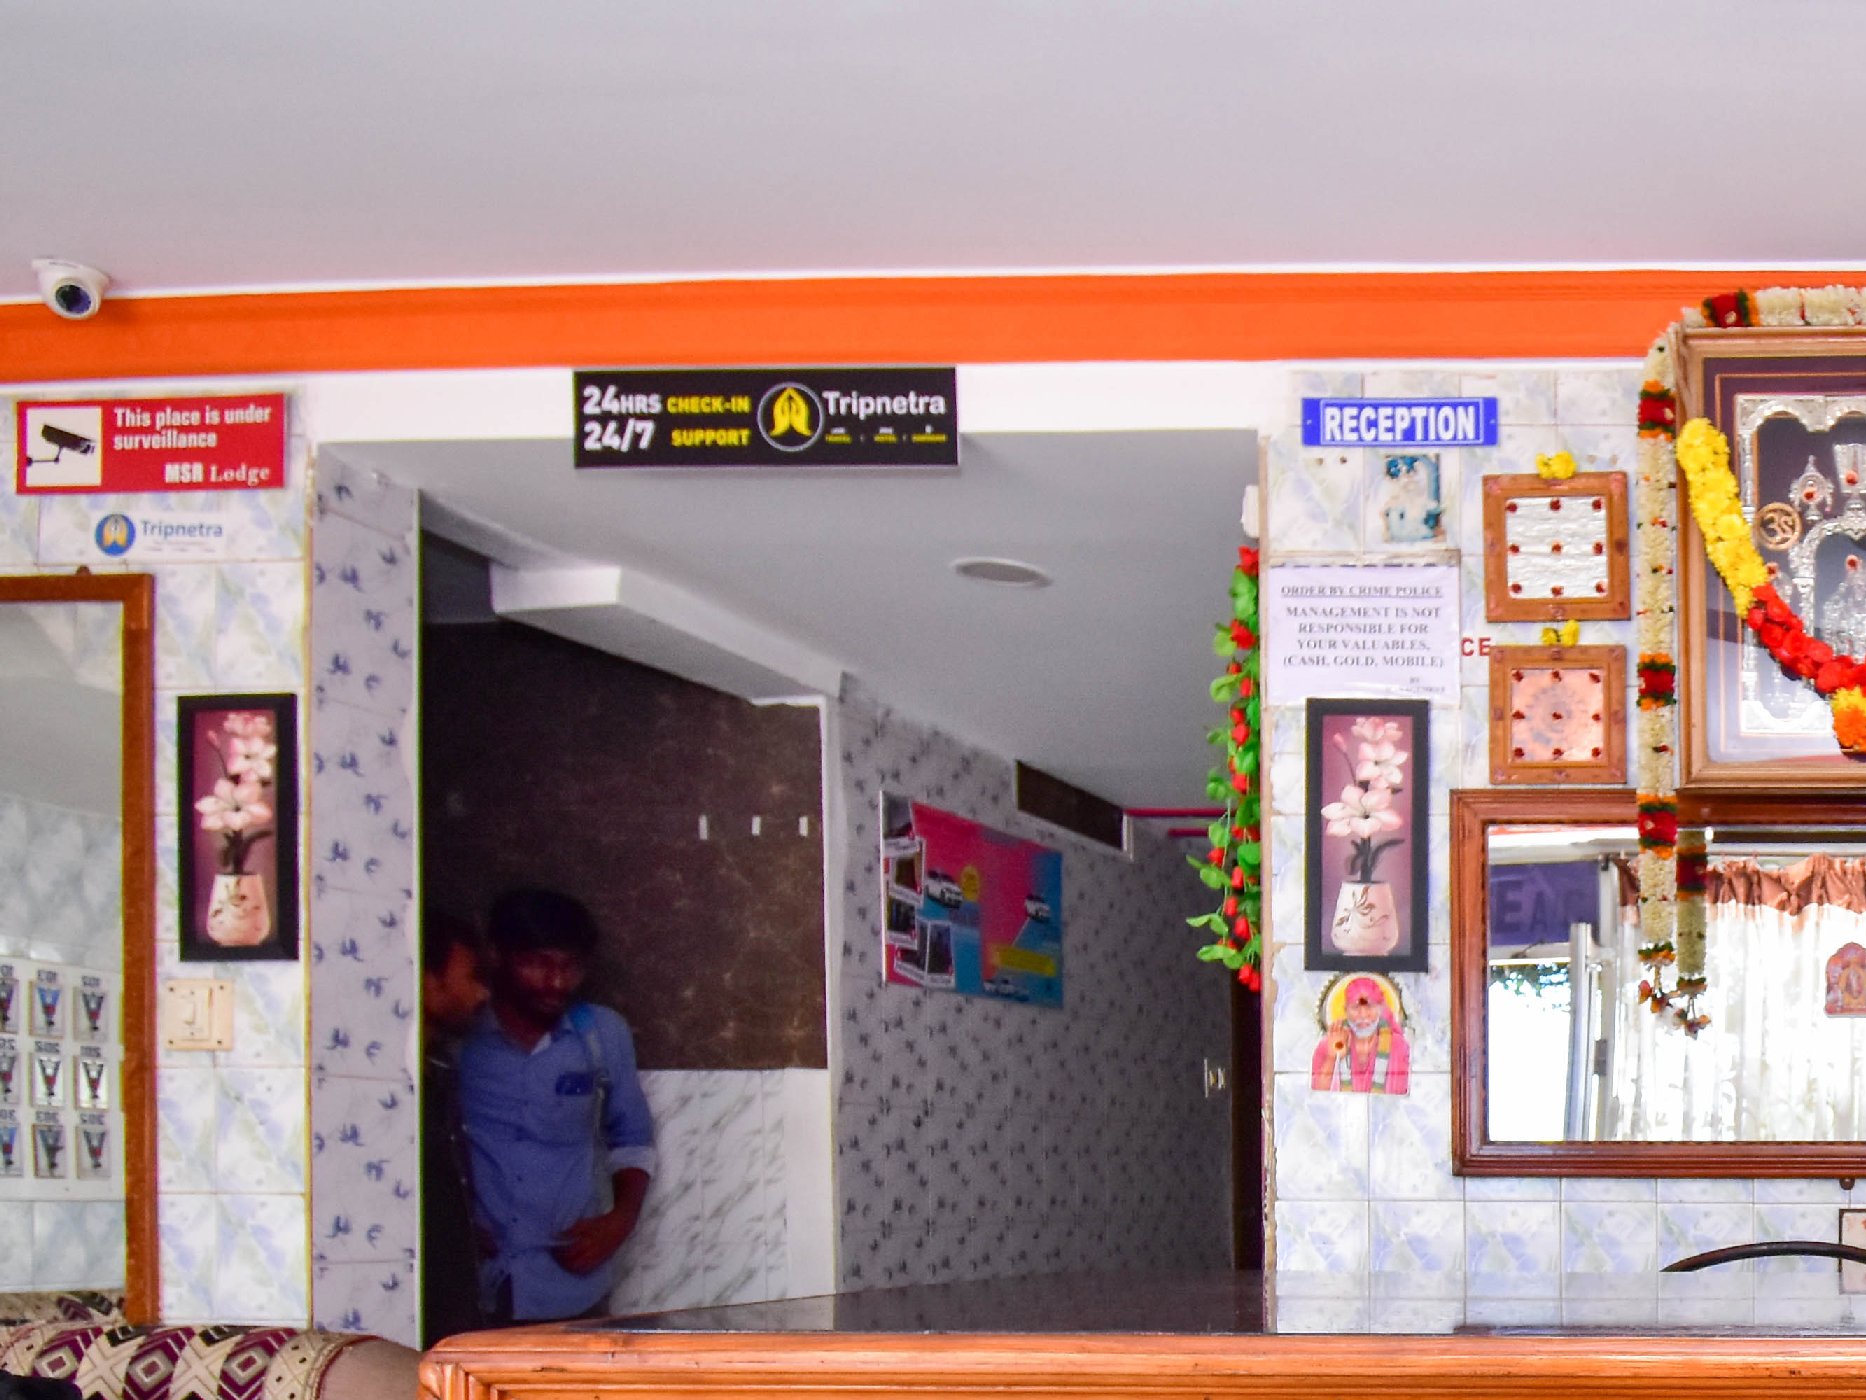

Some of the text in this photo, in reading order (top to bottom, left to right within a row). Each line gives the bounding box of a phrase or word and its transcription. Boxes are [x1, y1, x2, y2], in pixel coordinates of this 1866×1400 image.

[583, 385, 750, 415] 24HRS CHECK-IN
[822, 390, 946, 420] Tripnetra
[114, 403, 271, 431] This place is under
[1325, 405, 1475, 441] RECEPTION
[113, 428, 218, 450] surveillance
[583, 418, 750, 452] 24/7 SUPPORT
[164, 462, 270, 487] MSR Lodge
[140, 519, 223, 540] Tripnetra
[1286, 606, 1441, 618] MANAGEMENT IS NOT
[1298, 623, 1429, 634] RESPONSIBLE FOR
[1297, 639, 1337, 651] YOUR
